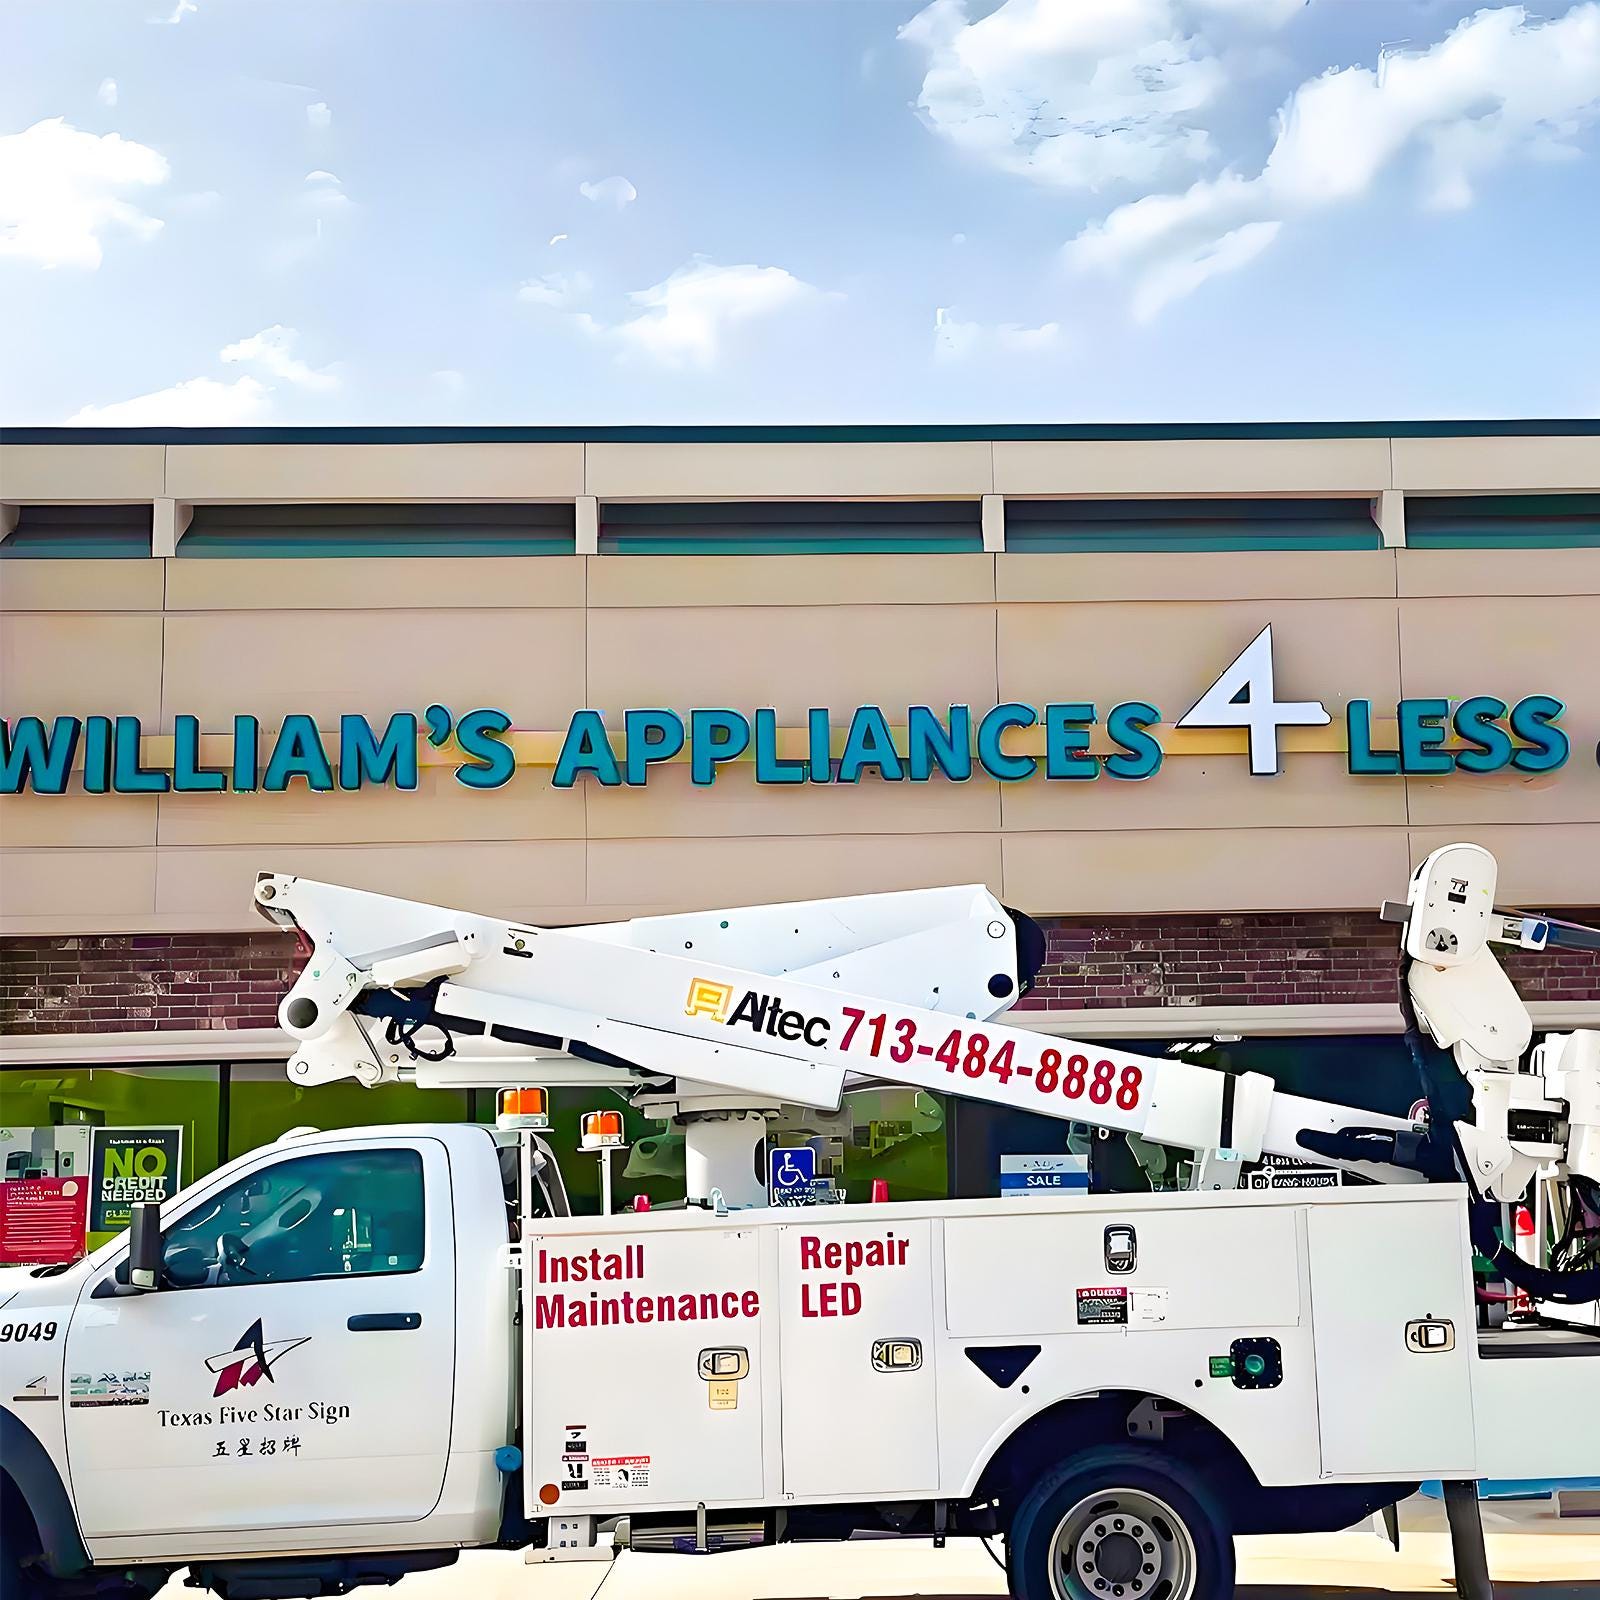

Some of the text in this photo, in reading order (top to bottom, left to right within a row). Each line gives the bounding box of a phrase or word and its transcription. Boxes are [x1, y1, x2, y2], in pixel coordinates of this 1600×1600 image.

[0, 623, 1570, 794] WILLIAM'S APPLIANCES 4 LESS
[726, 990, 1143, 1112] Altec 713-484-8888
[104, 1147, 167, 1178] NO
[101, 1189, 167, 1202] NEEDED
[1026, 1175, 1061, 1187] SALE
[538, 1245, 645, 1284] Install
[800, 1232, 910, 1276] Repair
[535, 1289, 761, 1330] Maintenance
[801, 1282, 863, 1318] LED
[0, 1321, 58, 1343] 9049
[157, 1402, 350, 1427] Texas Five Star Sign
